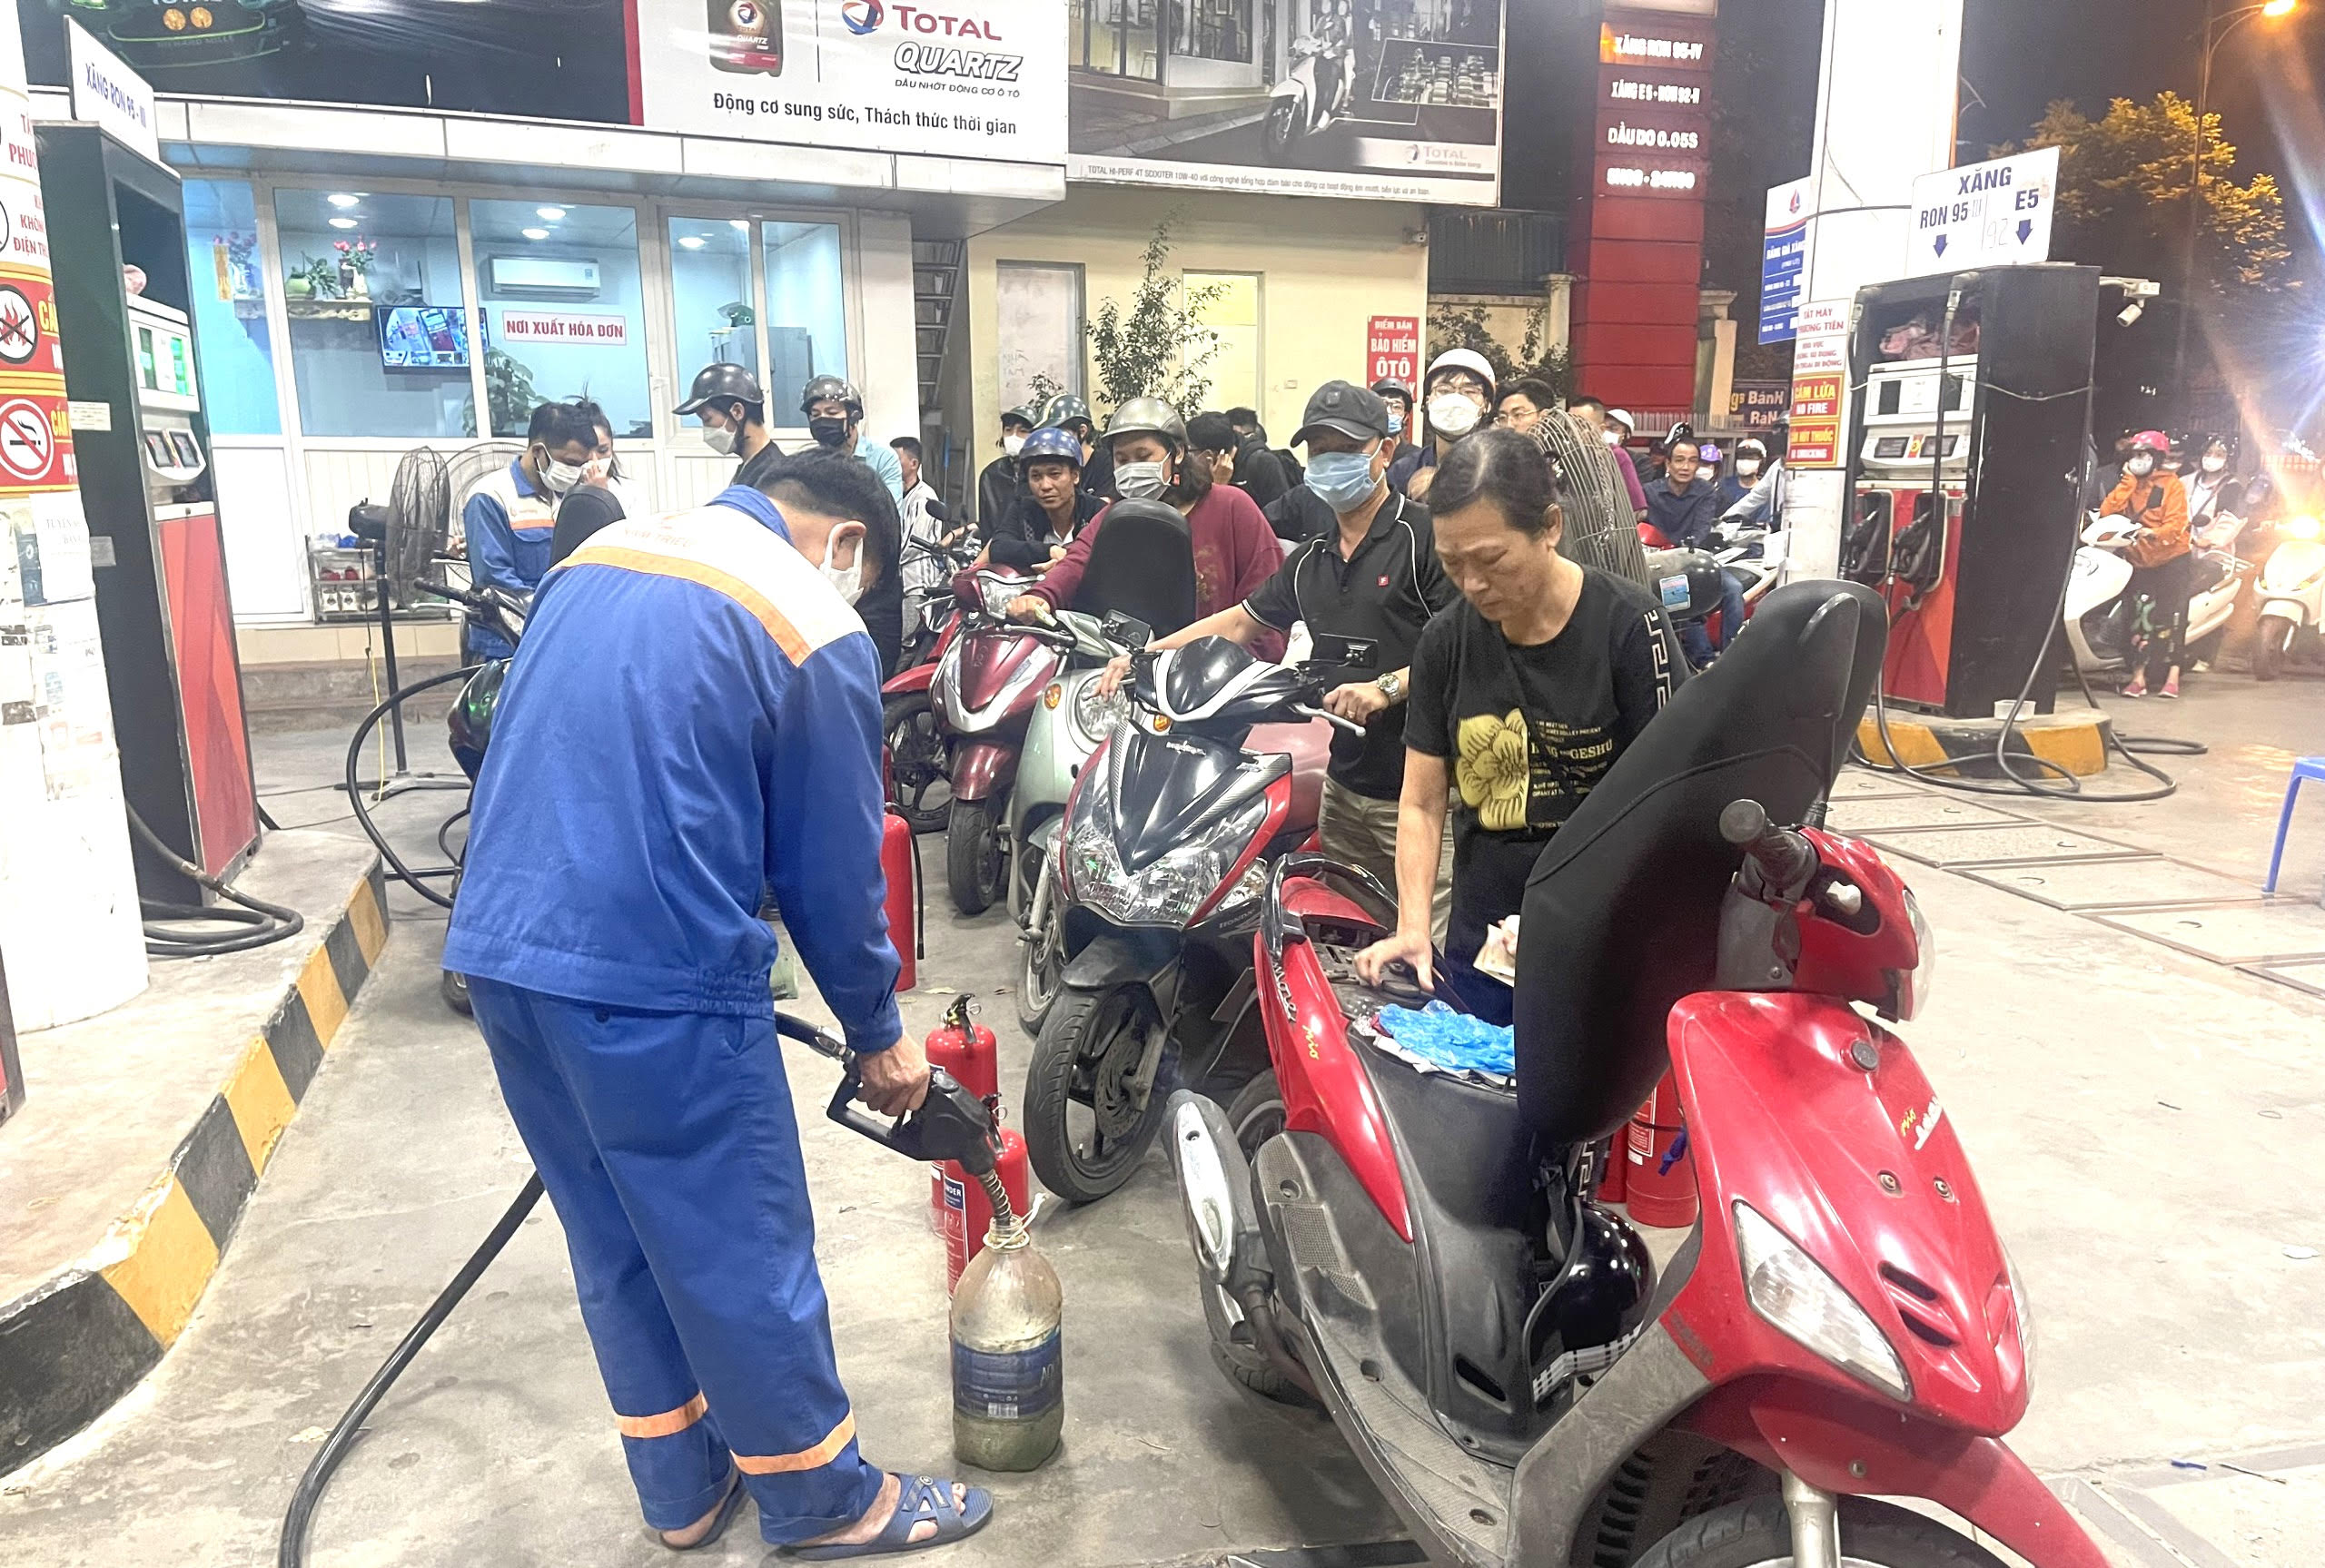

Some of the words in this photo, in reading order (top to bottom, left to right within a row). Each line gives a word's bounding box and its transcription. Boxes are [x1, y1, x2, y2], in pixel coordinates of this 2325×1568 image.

[892, 5, 1002, 41] TOTAL
[737, 35, 768, 44] QUARTZ
[895, 41, 1024, 82] QUARTZ
[714, 93, 755, 116] Động
[760, 100, 778, 113] cơ
[785, 104, 822, 121] sung
[828, 104, 859, 123] sức,
[865, 106, 910, 125] Thách
[915, 112, 948, 128] thức
[954, 115, 981, 131] thời
[986, 118, 1016, 135] gian
[1657, 131, 1698, 148] 0.05S
[1088, 164, 1107, 175] TOTAL
[1144, 169, 1173, 179] SCOOTER
[1958, 166, 2012, 195] XĂNG
[2014, 188, 2040, 211] E5
[1920, 205, 1948, 229] RON
[506, 320, 529, 334] NƠI
[532, 318, 564, 335] XUẤT
[1376, 356, 1410, 378] ÔTÔ
[1807, 402, 1828, 415] FIRE
